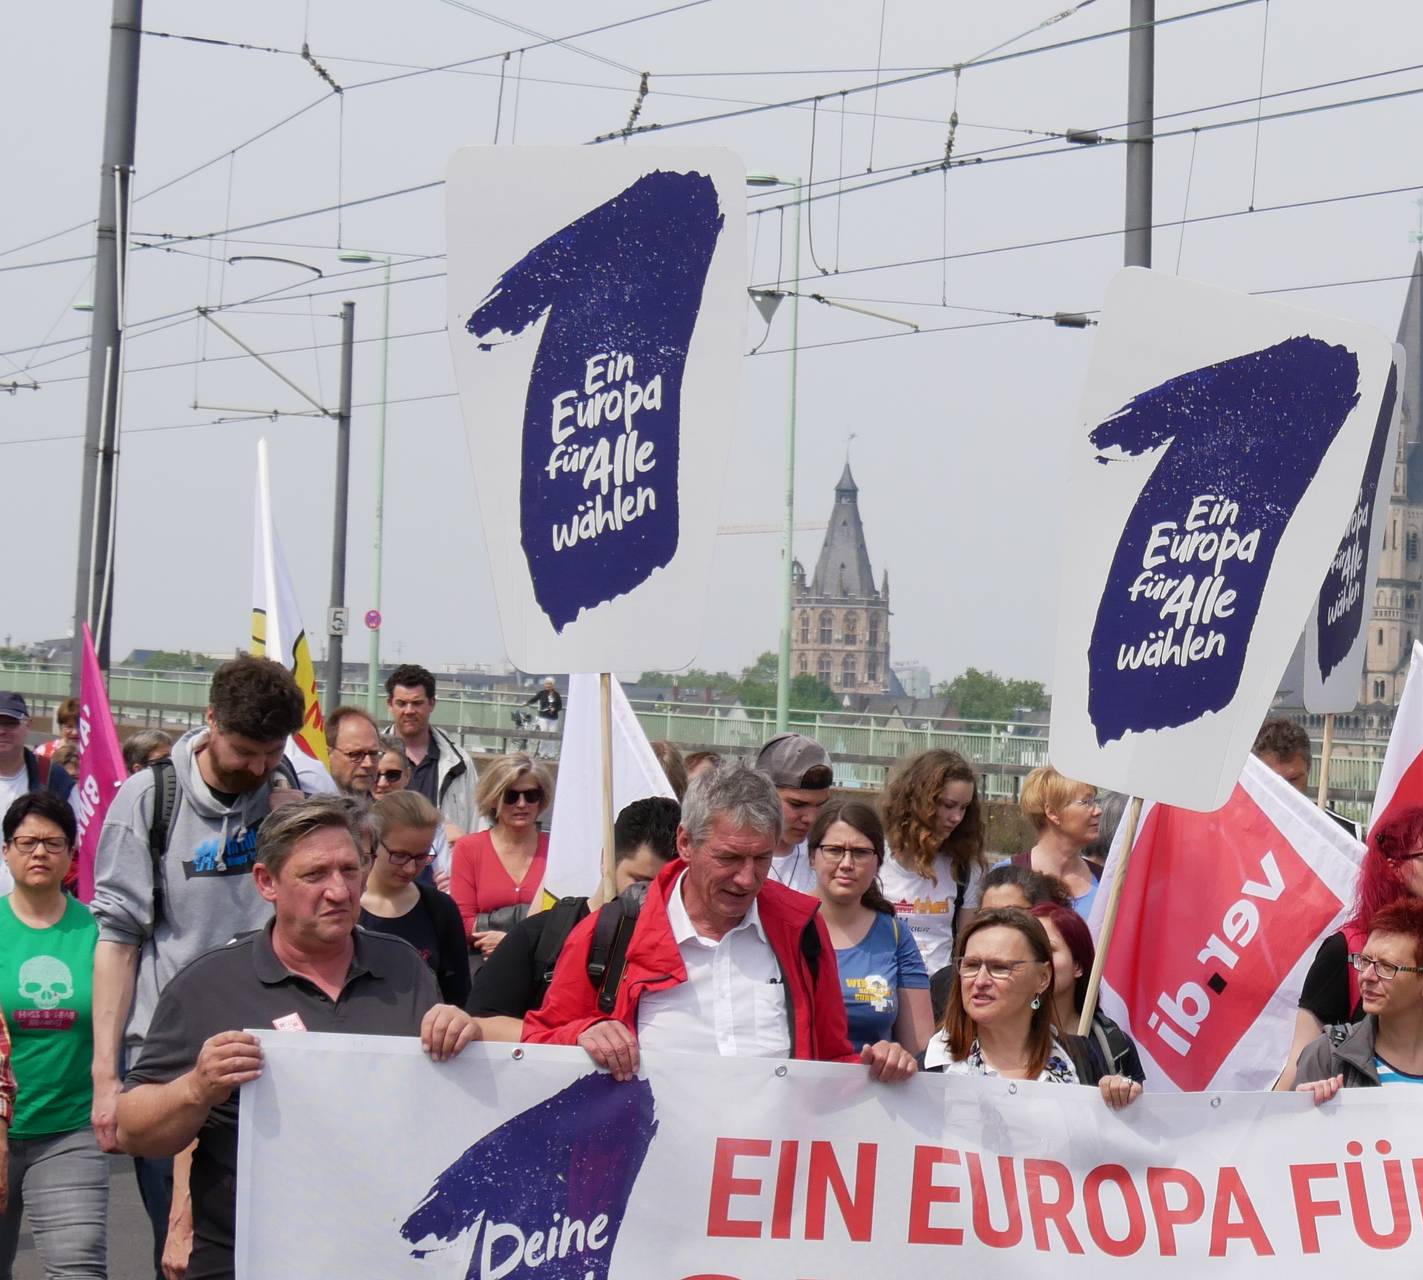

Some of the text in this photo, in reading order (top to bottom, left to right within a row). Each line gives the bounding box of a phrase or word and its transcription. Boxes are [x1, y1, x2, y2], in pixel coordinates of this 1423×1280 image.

[584, 350, 634, 395] Ein
[551, 374, 662, 444] Europa
[545, 430, 657, 495] für Alle
[552, 486, 656, 551] wählen
[1185, 495, 1239, 531] Ein
[1142, 522, 1261, 577] Europa
[1341, 541, 1363, 586] Alle
[332, 610, 345, 631] 5
[1128, 571, 1237, 629] für Alle
[1327, 581, 1361, 626] wählen
[1117, 625, 1226, 671] wählen
[706, 1136, 878, 1242] EIN
[907, 1144, 1276, 1258] EUROPA
[480, 1212, 609, 1280] Deine
